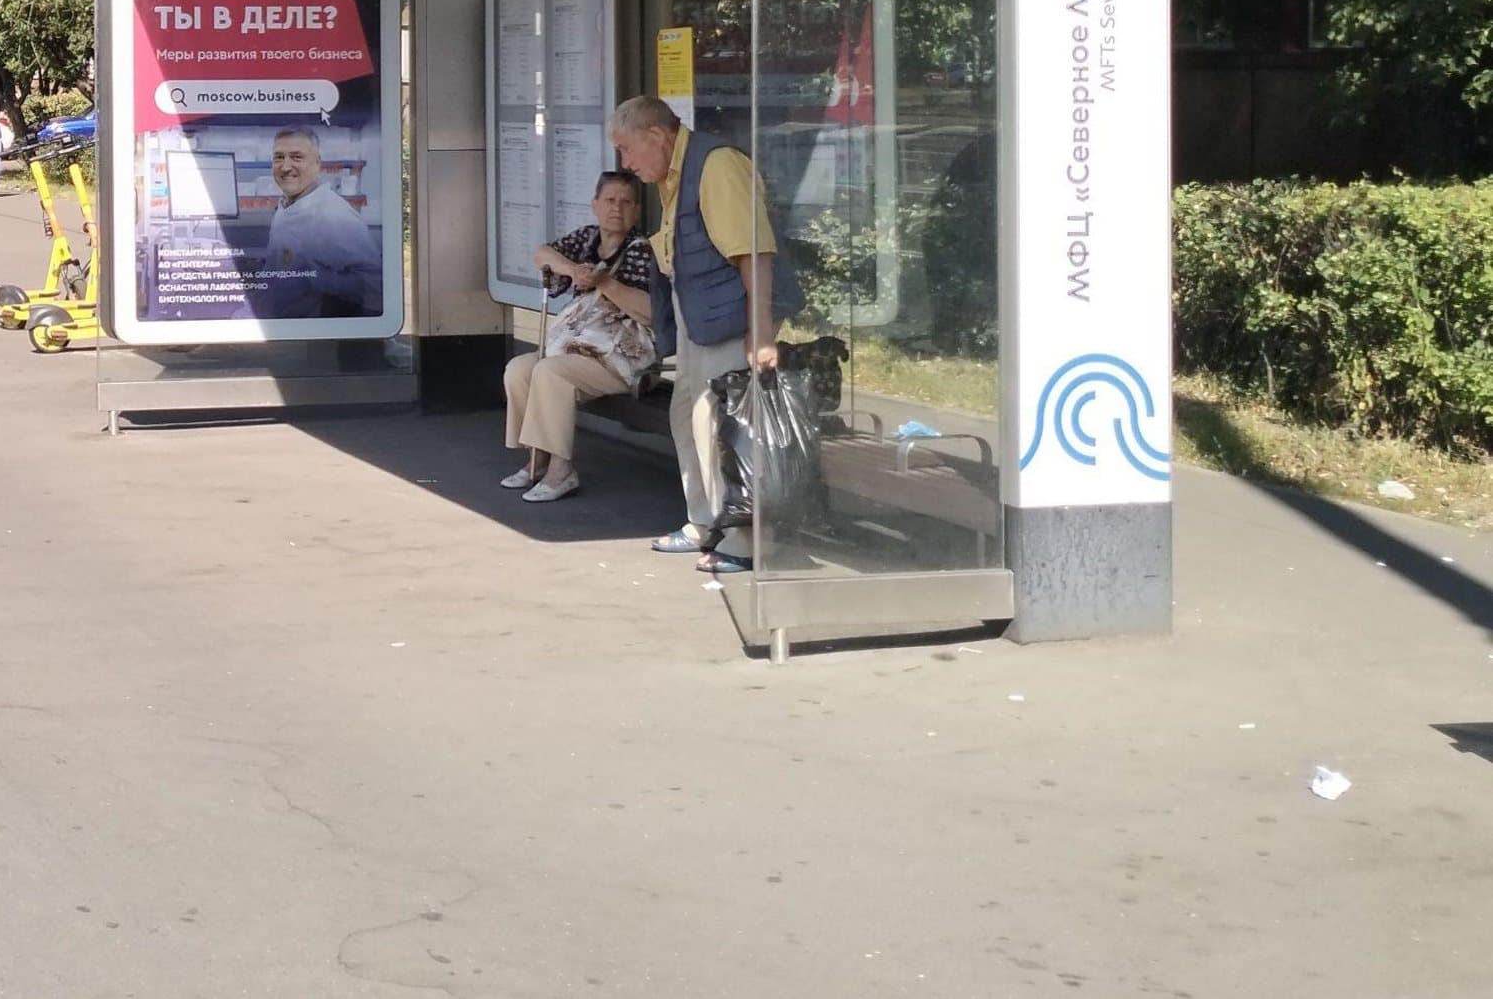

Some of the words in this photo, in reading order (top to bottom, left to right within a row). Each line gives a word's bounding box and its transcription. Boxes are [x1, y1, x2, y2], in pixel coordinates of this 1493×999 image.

[154, 5, 202, 30] ТЫ
[213, 5, 233, 30] В
[241, 5, 338, 34] ДЕЛЕ?
[156, 48, 194, 62] Меры
[197, 50, 257, 62] развития
[261, 49, 305, 60] твоего
[308, 48, 363, 60] бизнеса
[1099, 35, 1116, 92] MFTs
[197, 89, 316, 103] moscow.business
[1066, 25, 1095, 202] «Северное
[1066, 211, 1094, 303] МФЦ
[158, 272, 170, 280] НА
[170, 271, 212, 281] СРЕДСТВА
[213, 270, 241, 280] ГРАНТА
[254, 270, 318, 279] ОБОРУДОВАНИЕ
[158, 283, 209, 292] ОСНАСТИЛИ
[209, 282, 269, 291] ЛАБОРАТОРИЮ
[158, 295, 229, 304] БИОТЕХНОЛОГИИ
